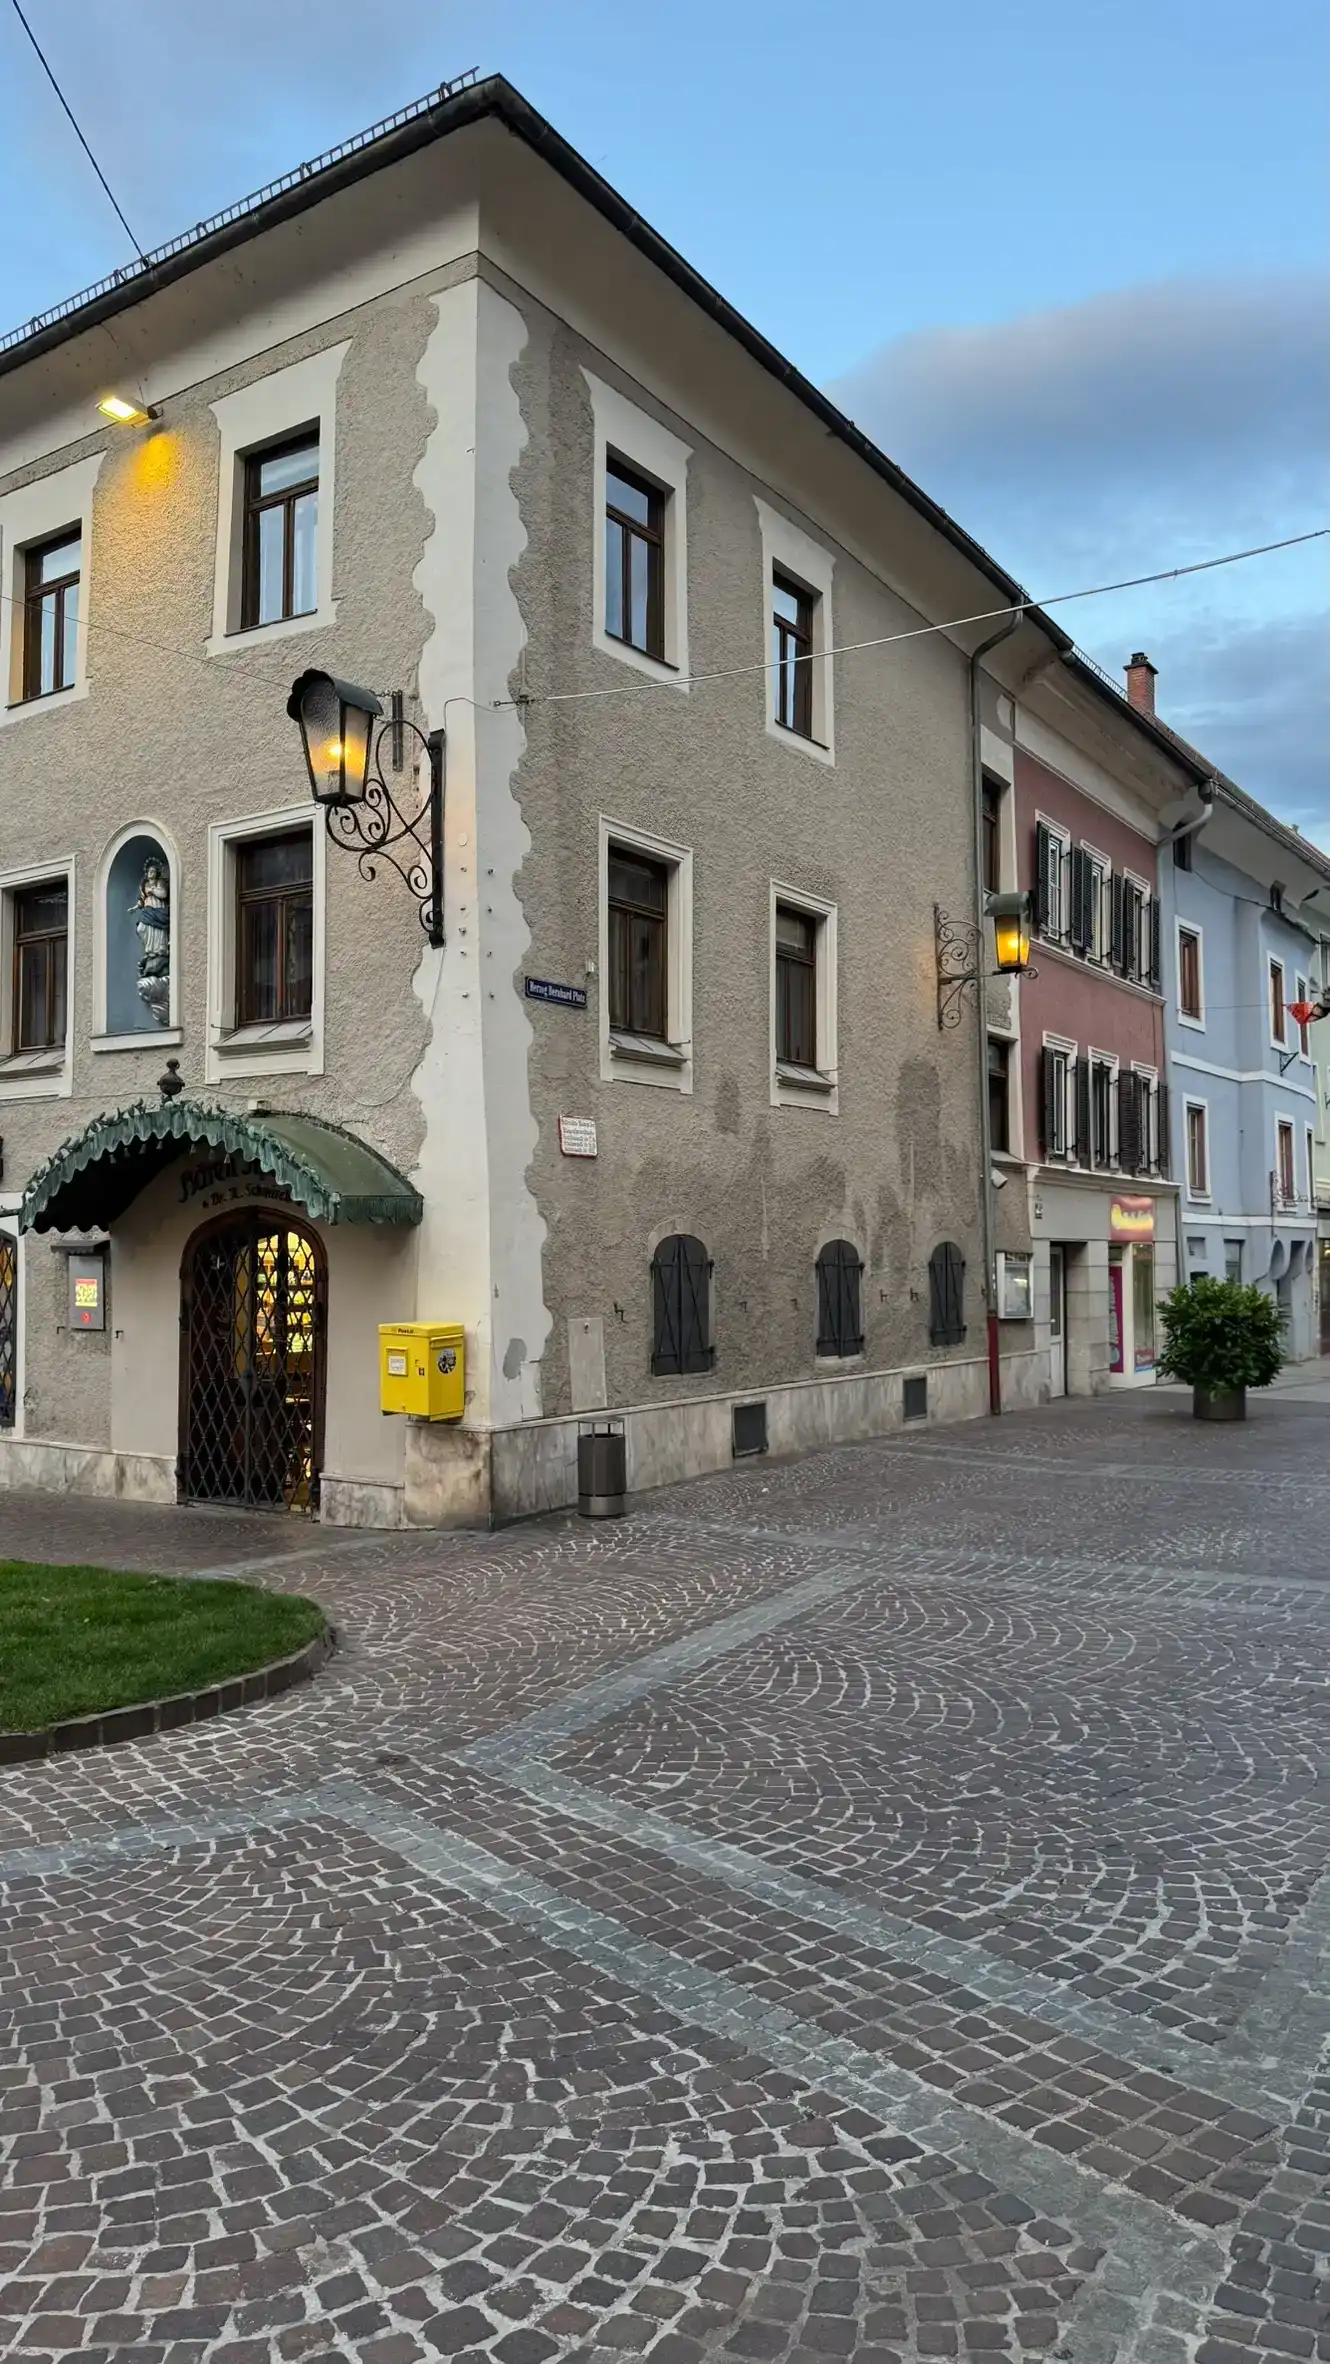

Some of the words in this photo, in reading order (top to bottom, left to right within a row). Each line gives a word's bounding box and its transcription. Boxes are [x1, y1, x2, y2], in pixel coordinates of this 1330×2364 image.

[530, 980, 548, 998] Herzog
[549, 985, 572, 1001] Bernhard
[573, 990, 585, 1003] Platz
